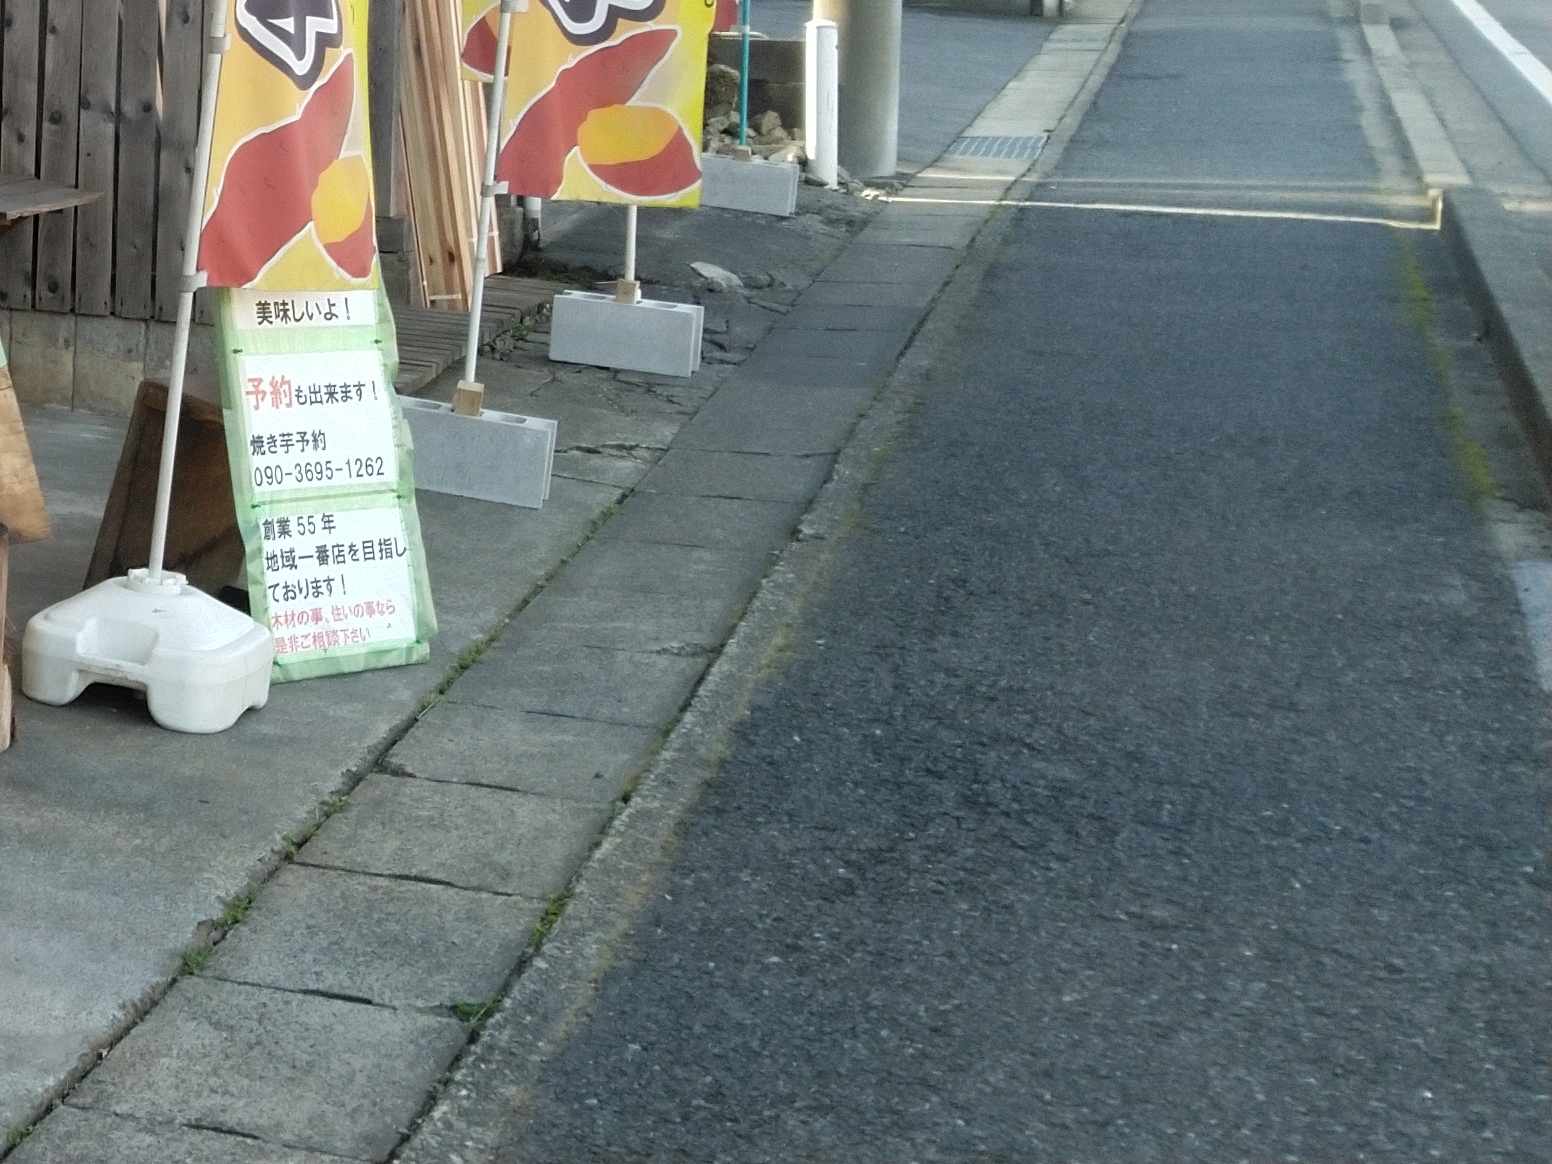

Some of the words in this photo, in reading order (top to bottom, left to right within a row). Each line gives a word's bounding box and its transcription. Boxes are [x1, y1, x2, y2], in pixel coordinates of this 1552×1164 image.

[249, 428, 327, 457] 焼き芋予約
[253, 456, 385, 487] 090-3695-1262
[265, 537, 407, 573] 地域一番店を目指し
[272, 599, 396, 631] 木材の事、住いの事なら
[275, 627, 372, 655] 是非ご相談下さい
